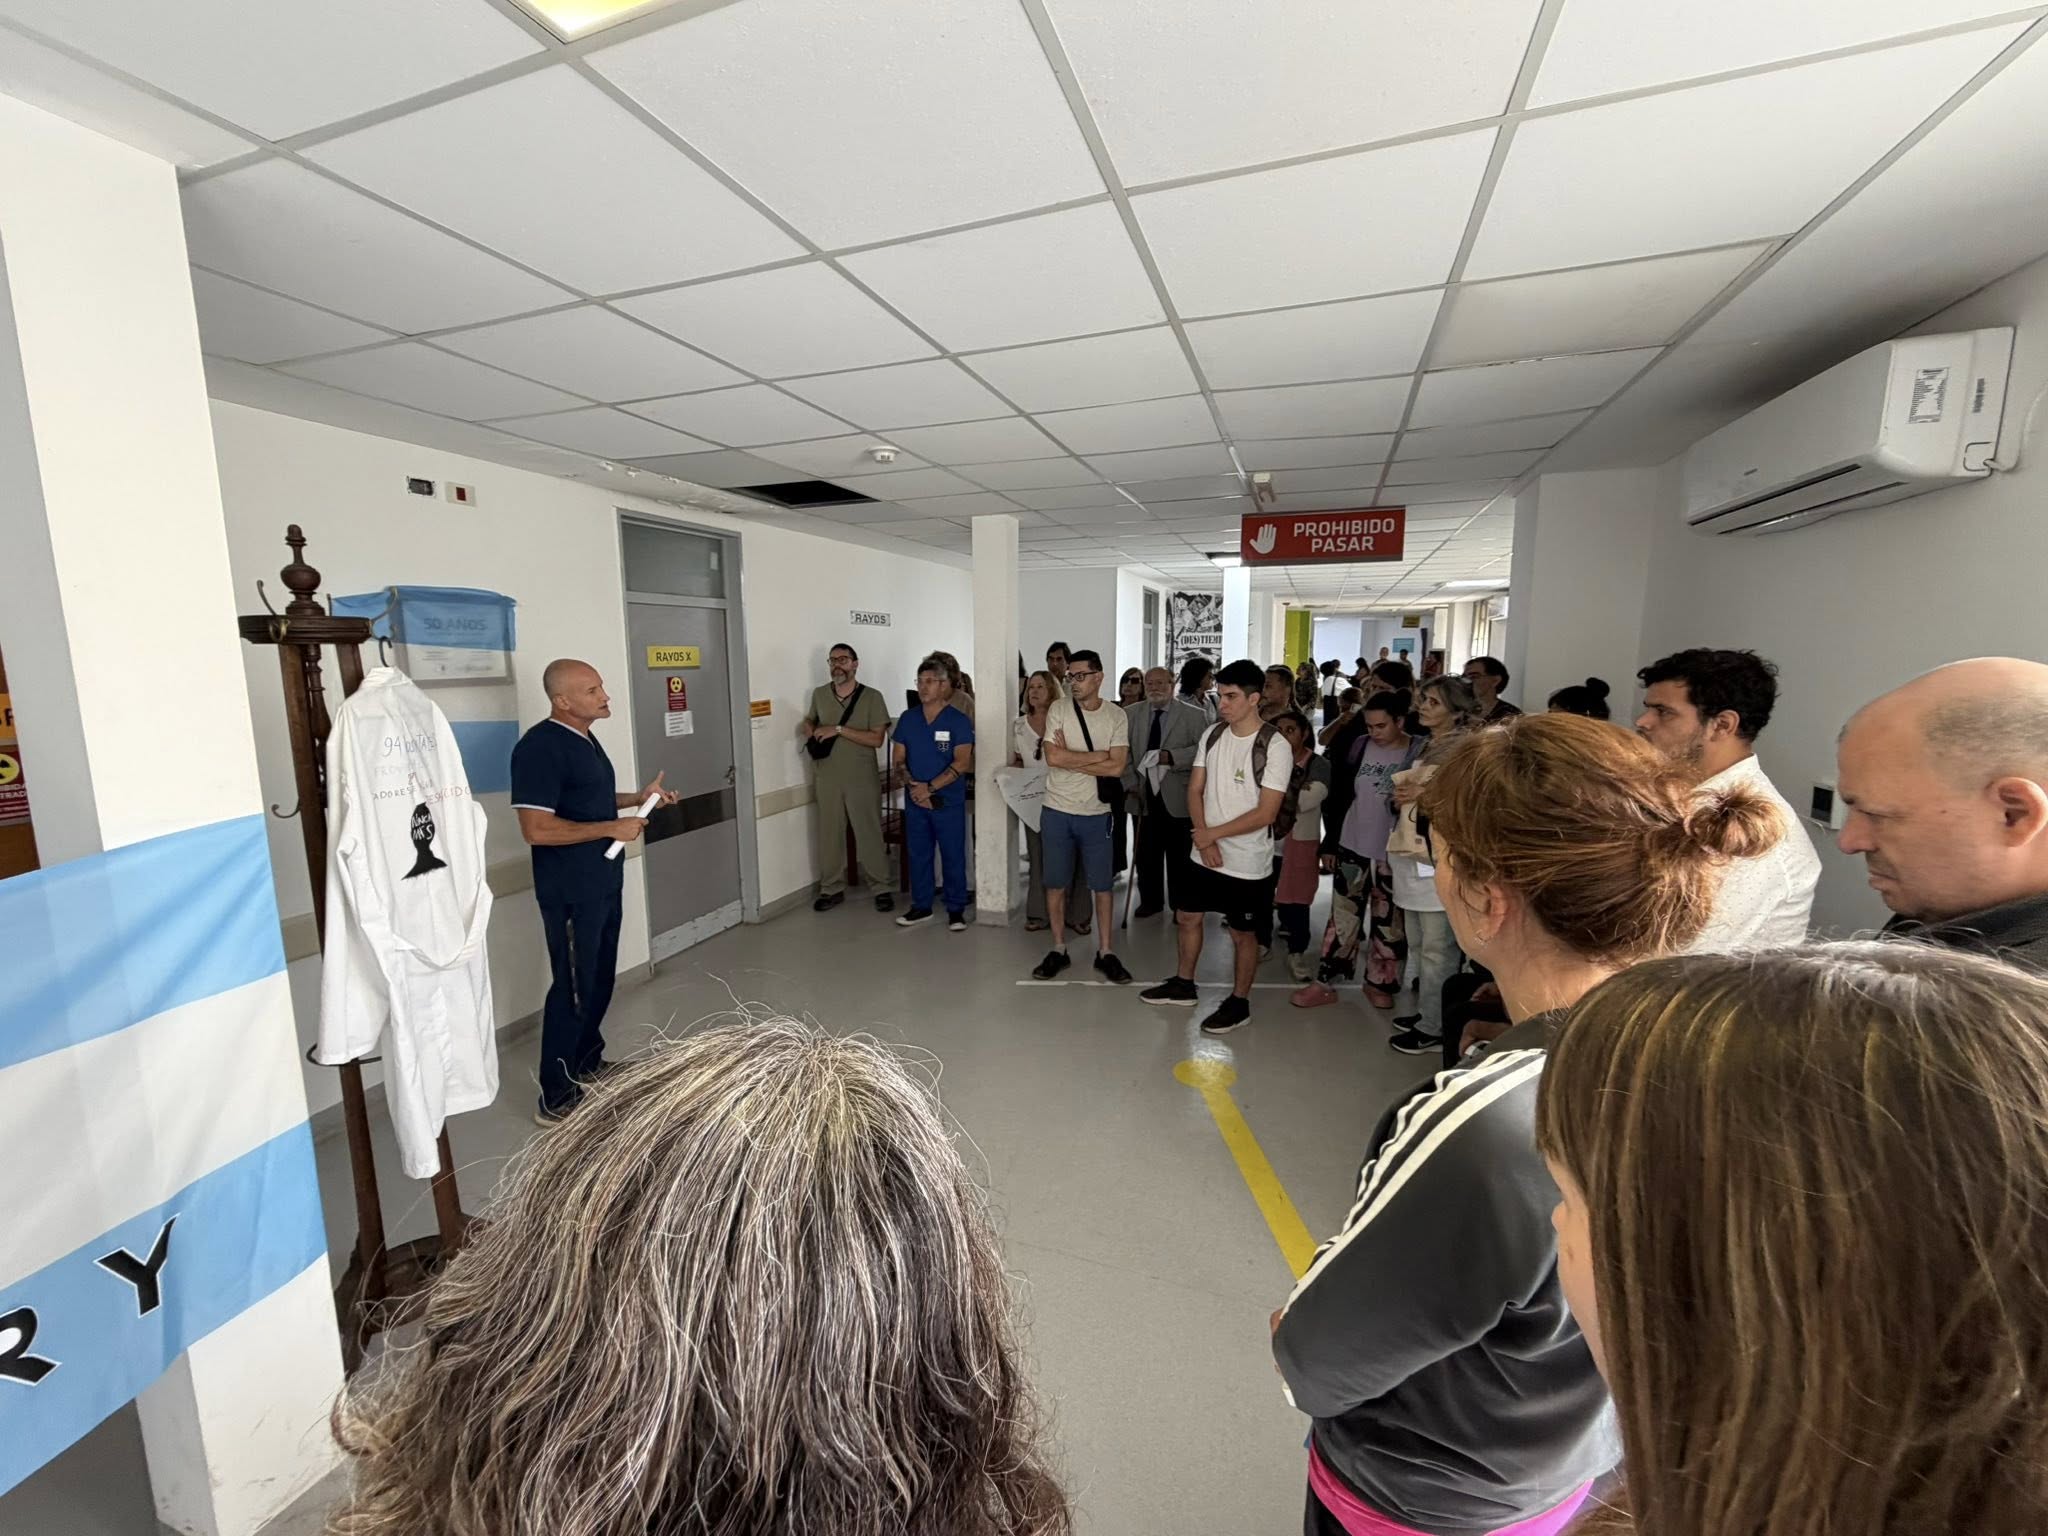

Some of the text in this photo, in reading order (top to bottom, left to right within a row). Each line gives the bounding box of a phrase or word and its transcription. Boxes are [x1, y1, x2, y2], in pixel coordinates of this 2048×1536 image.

[1294, 518, 1395, 537] PROHIBIDO
[1311, 536, 1375, 553] PASAR
[855, 613, 886, 625] RAYOS
[656, 652, 692, 662] RAYOS X
